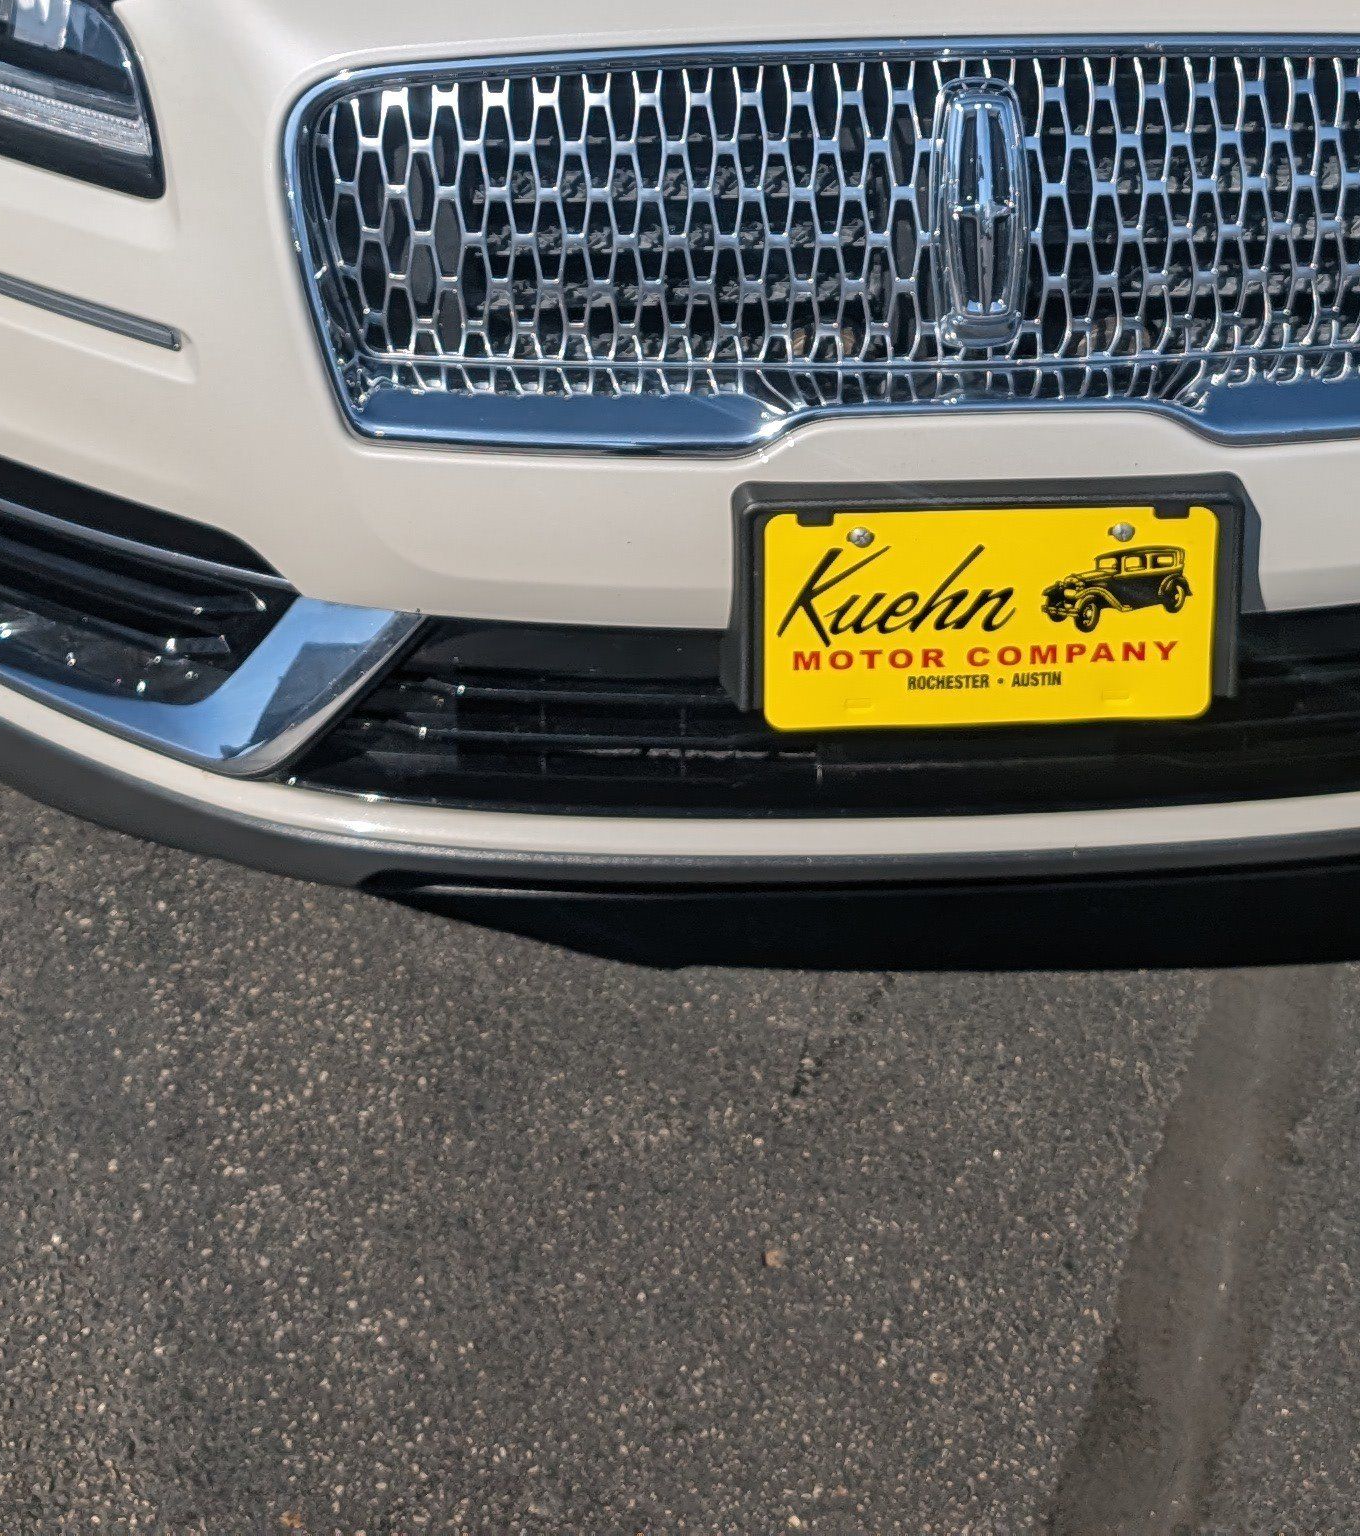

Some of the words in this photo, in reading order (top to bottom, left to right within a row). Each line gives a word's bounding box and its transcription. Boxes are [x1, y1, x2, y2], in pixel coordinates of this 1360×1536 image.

[777, 544, 1016, 648] Kuehn
[792, 648, 945, 672] MOTOR
[966, 640, 1180, 667] COMPANY
[907, 674, 990, 691] ROCHESTER
[1011, 671, 1062, 688] AUSTIN
